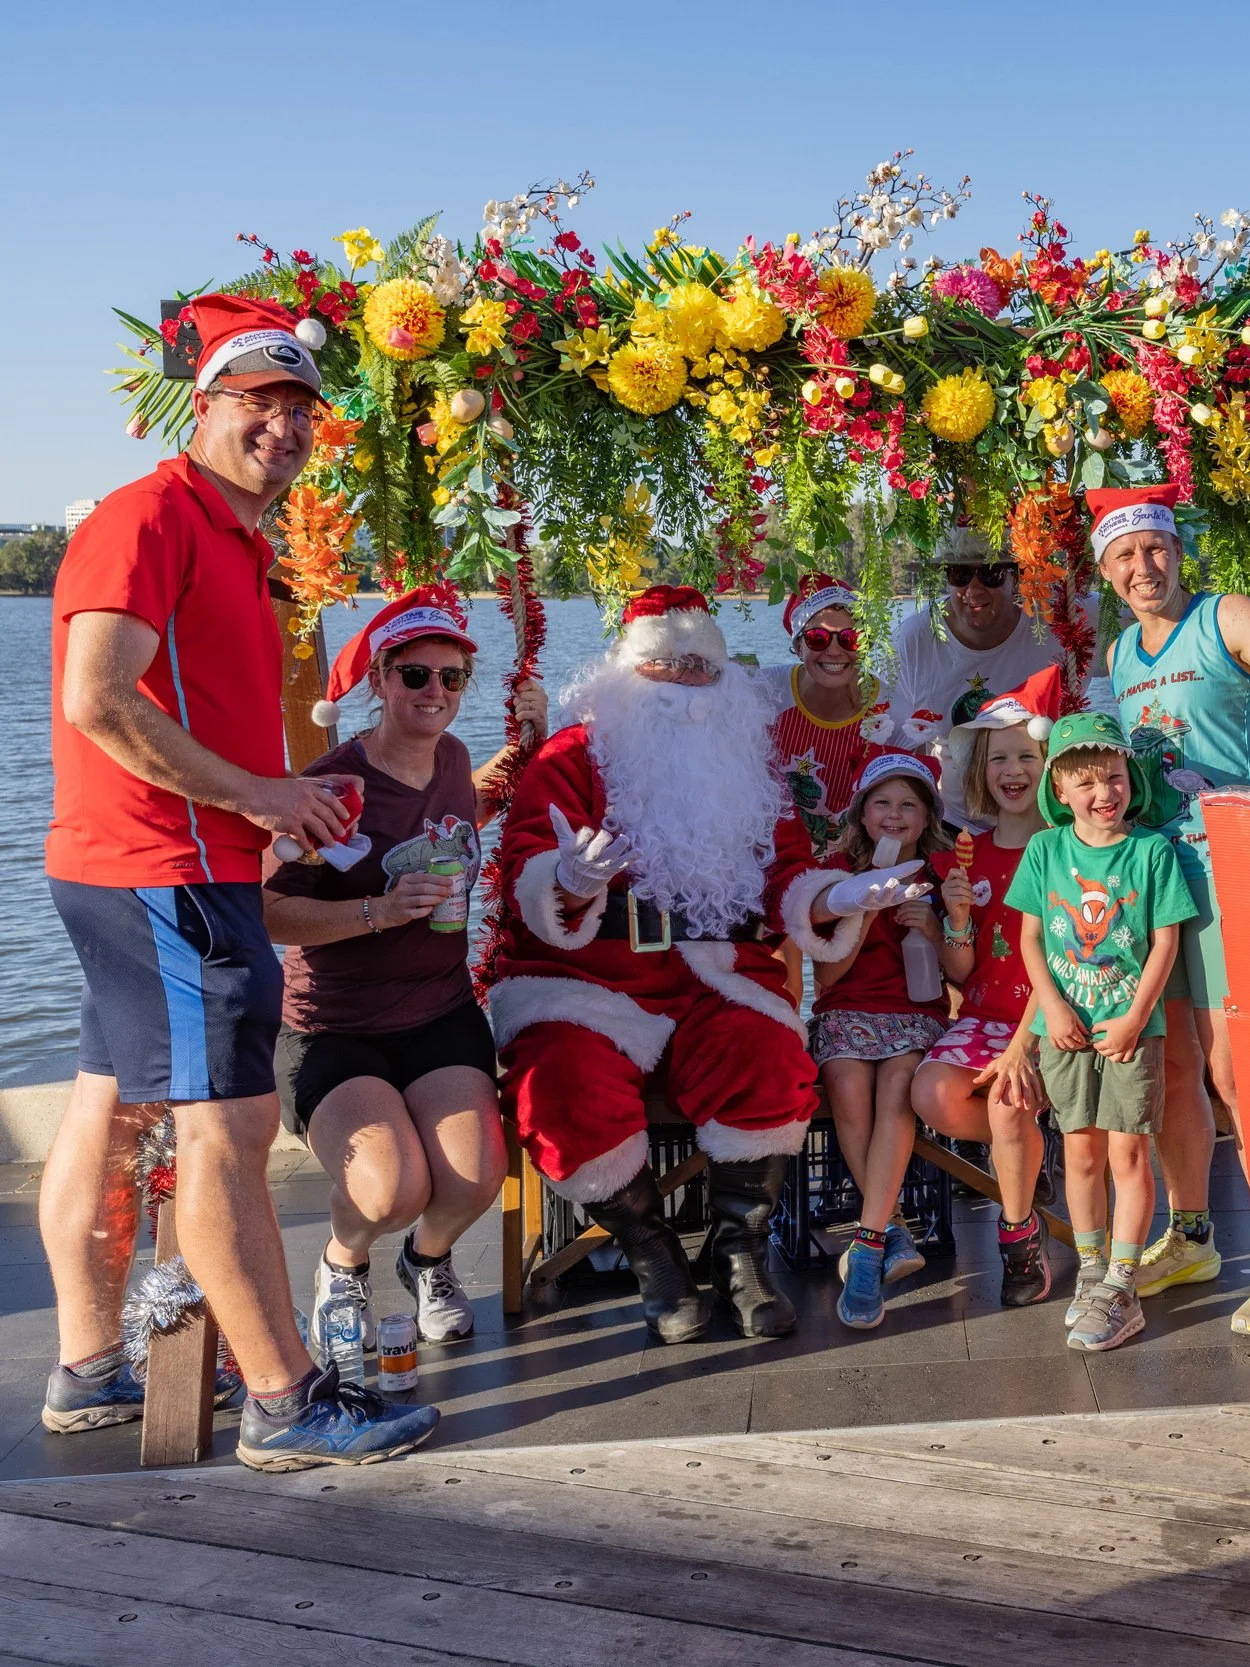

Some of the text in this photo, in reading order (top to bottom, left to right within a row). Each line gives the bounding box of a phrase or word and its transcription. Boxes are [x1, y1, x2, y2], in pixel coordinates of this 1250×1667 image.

[1127, 679, 1157, 698] MAKING
[1160, 676, 1167, 686] A
[1052, 955, 1075, 979] WAS
[1075, 965, 1125, 986] AMAZING
[1065, 982, 1095, 1009] ALL
